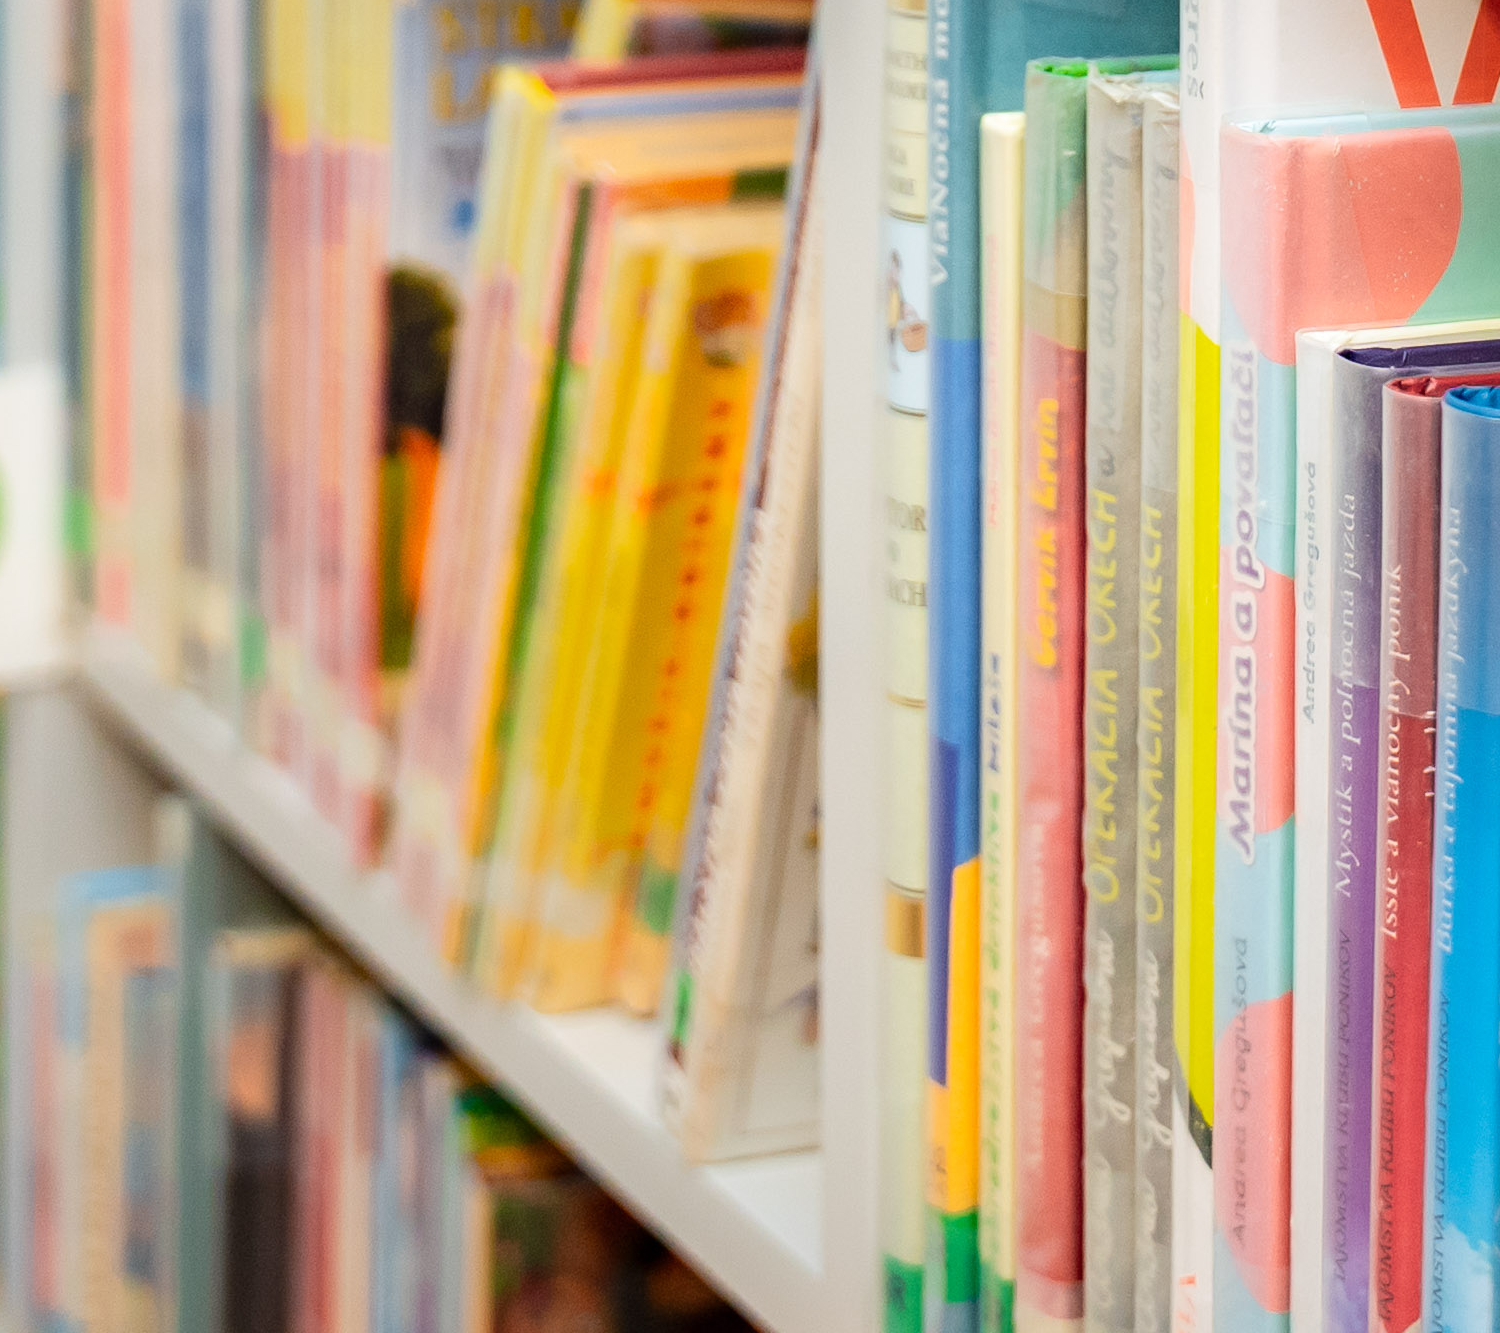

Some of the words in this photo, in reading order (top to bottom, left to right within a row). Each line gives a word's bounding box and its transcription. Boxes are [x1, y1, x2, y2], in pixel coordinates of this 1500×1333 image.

[1090, 489, 1118, 645] ORECH
[1301, 461, 1319, 611] Gregušová
[1336, 493, 1361, 581] jazda
[1233, 602, 1251, 634] a
[1301, 621, 1317, 723] Andrea
[1227, 657, 1254, 856] Marína
[1339, 755, 1354, 771] a
[1334, 785, 1360, 897] Mystik
[1384, 839, 1398, 856] a
[1441, 825, 1455, 843] a
[1380, 866, 1399, 939] Issie
[1229, 938, 1252, 1111] Gregušová
[1332, 1054, 1351, 1134] KLUBU
[1379, 1090, 1397, 1171] KLUBU
[1230, 1126, 1248, 1246] Andrea
[1433, 1118, 1450, 1204] KLUBU
